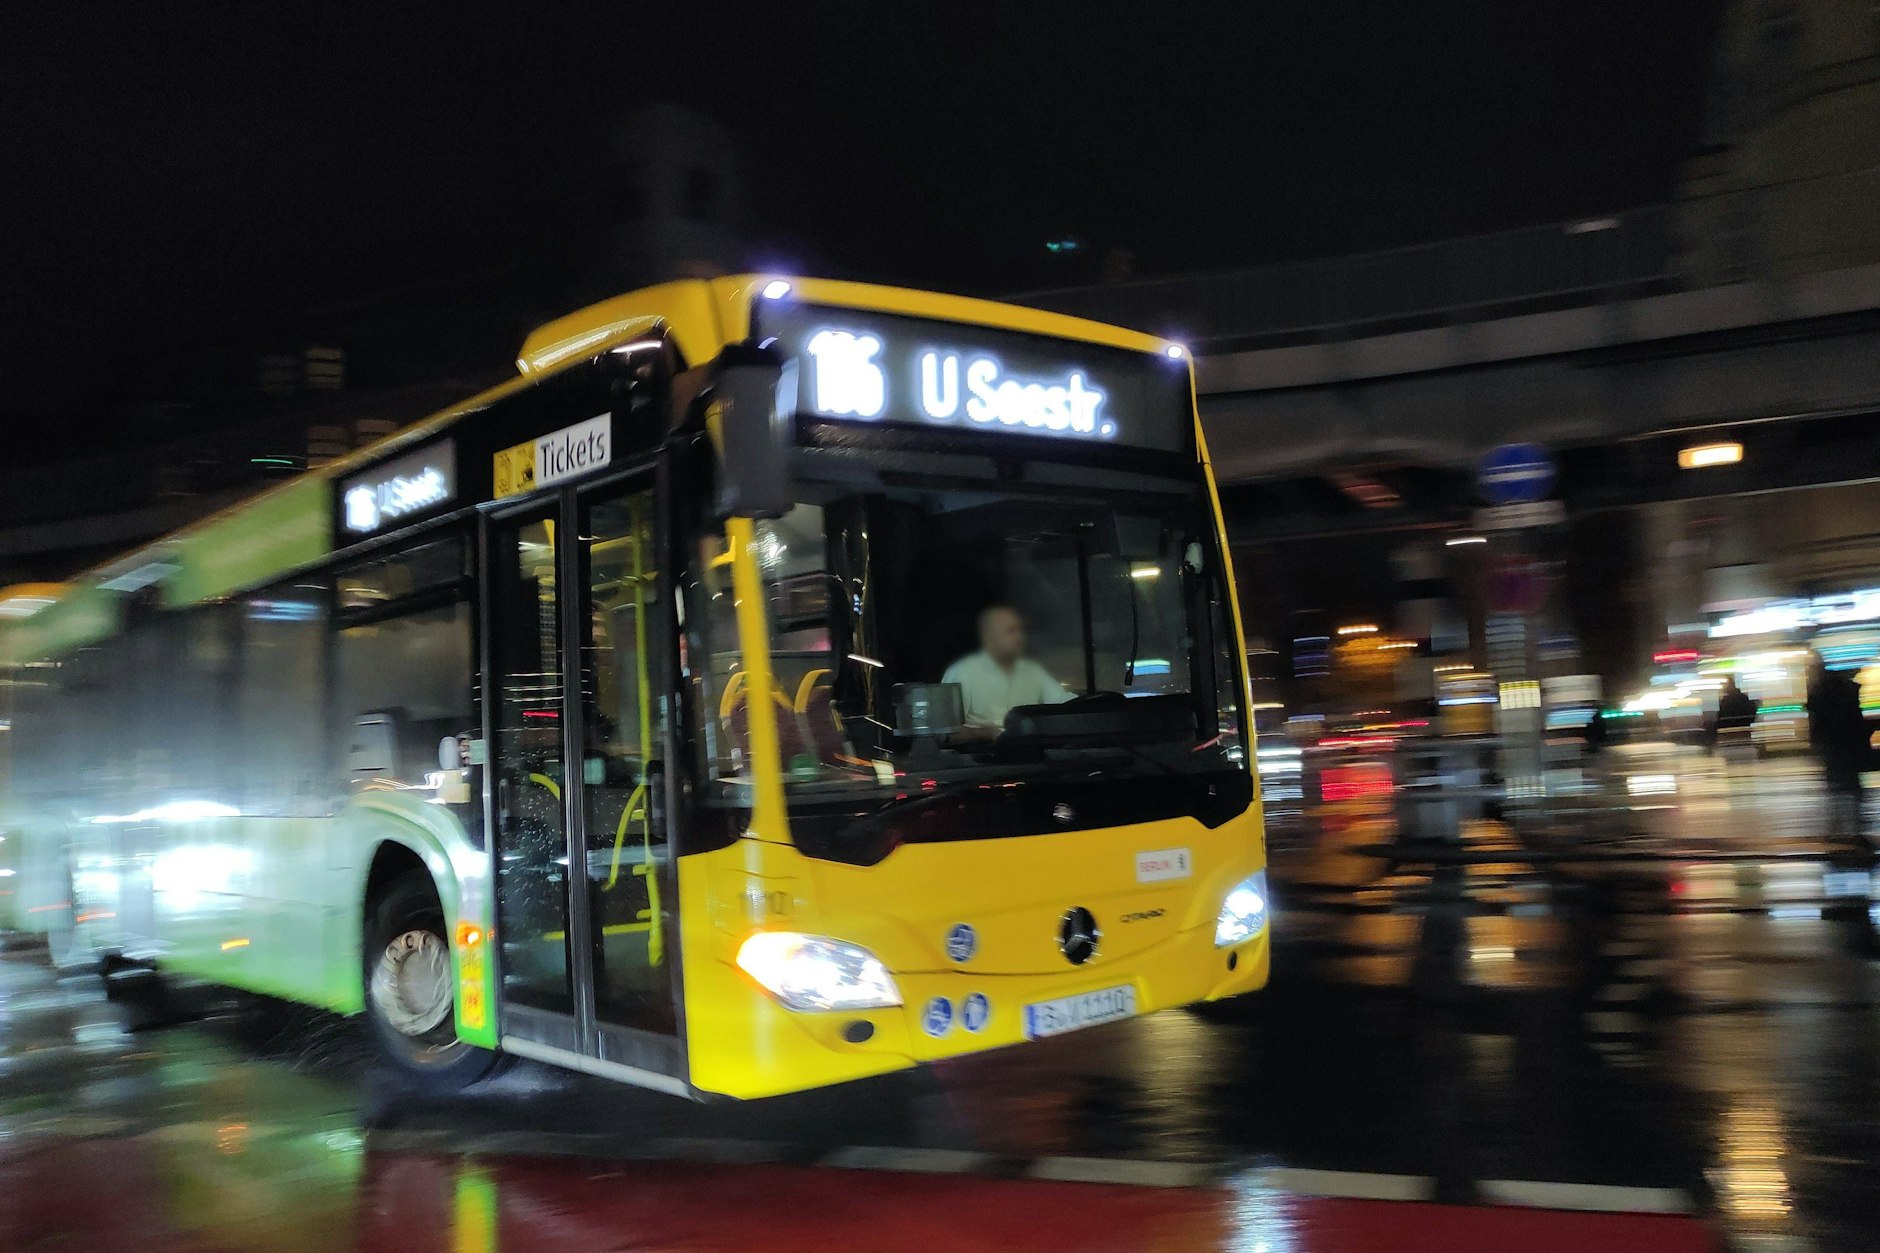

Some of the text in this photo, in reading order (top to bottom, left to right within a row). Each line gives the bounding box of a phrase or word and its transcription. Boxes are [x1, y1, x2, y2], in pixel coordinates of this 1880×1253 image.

[921, 351, 959, 418] U
[966, 358, 1113, 436] Seestr.
[540, 431, 606, 478] Tickets
